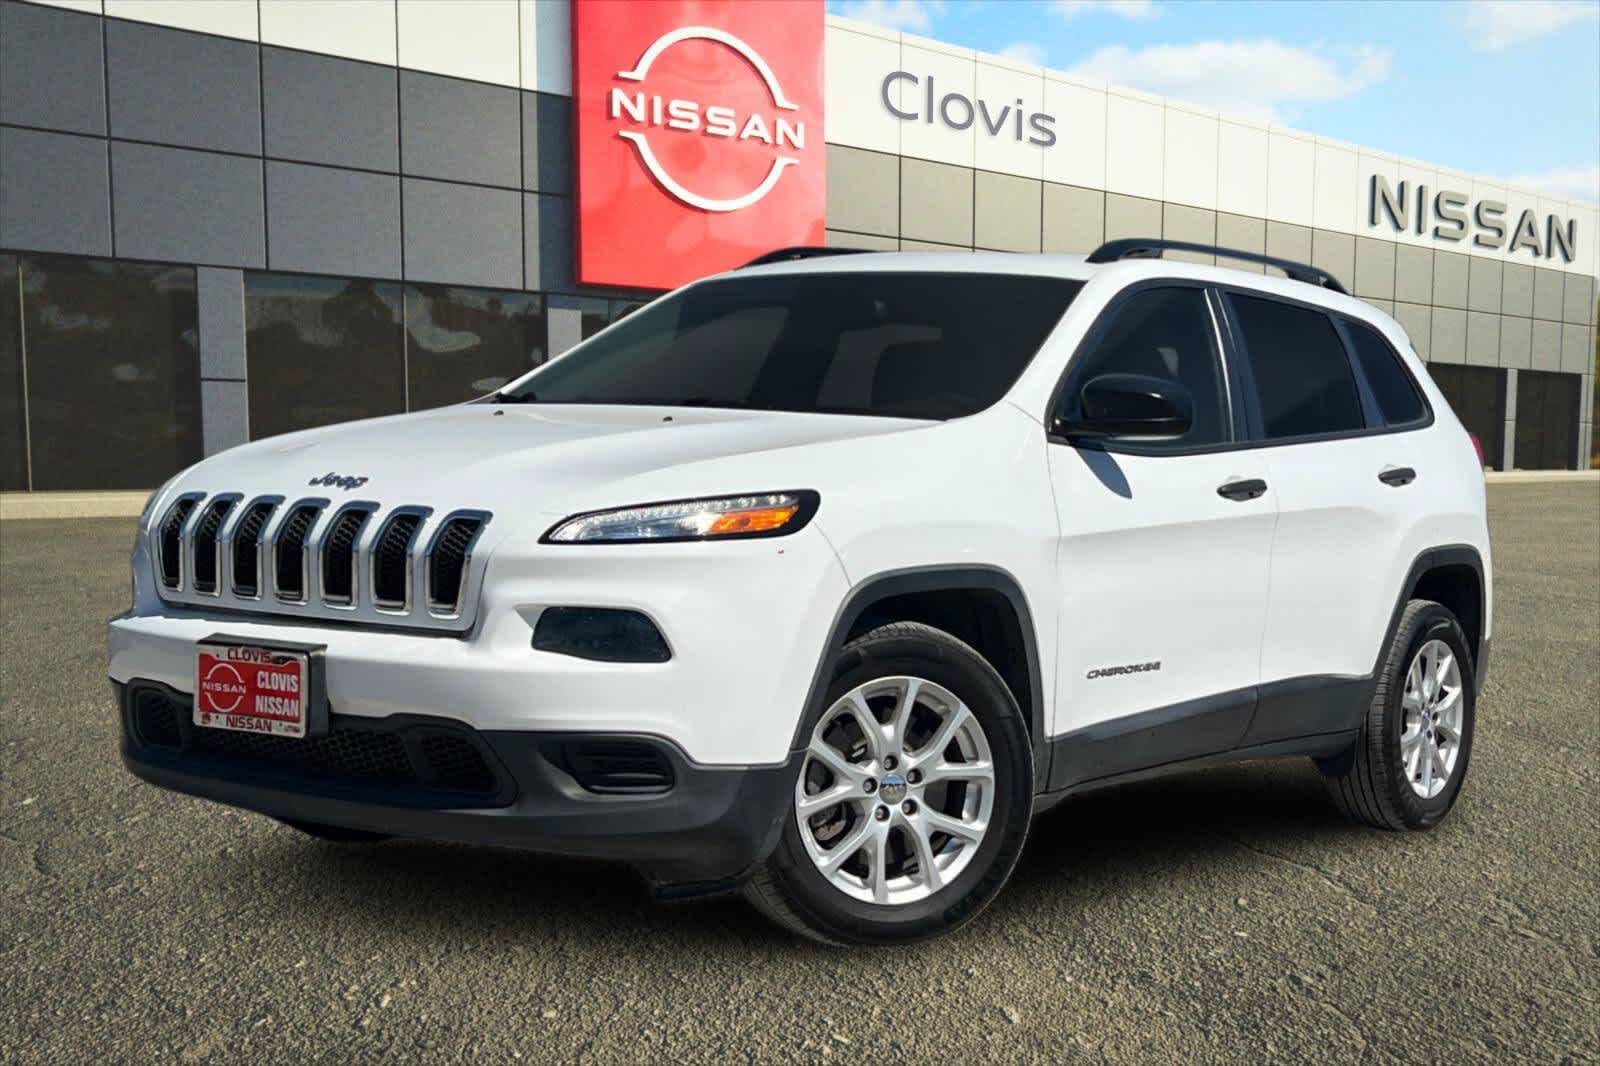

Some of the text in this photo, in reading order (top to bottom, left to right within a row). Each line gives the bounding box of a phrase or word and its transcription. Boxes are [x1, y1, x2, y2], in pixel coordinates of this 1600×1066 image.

[611, 87, 805, 149] NISSAN
[881, 71, 1057, 147] Clovis
[1368, 174, 1577, 262] NISSAN
[227, 647, 272, 664] CLOVIS
[202, 681, 246, 694] NISSAN
[257, 671, 298, 692] CLOVIS
[256, 695, 299, 718] NISSAN
[226, 715, 272, 732] NISSAN
